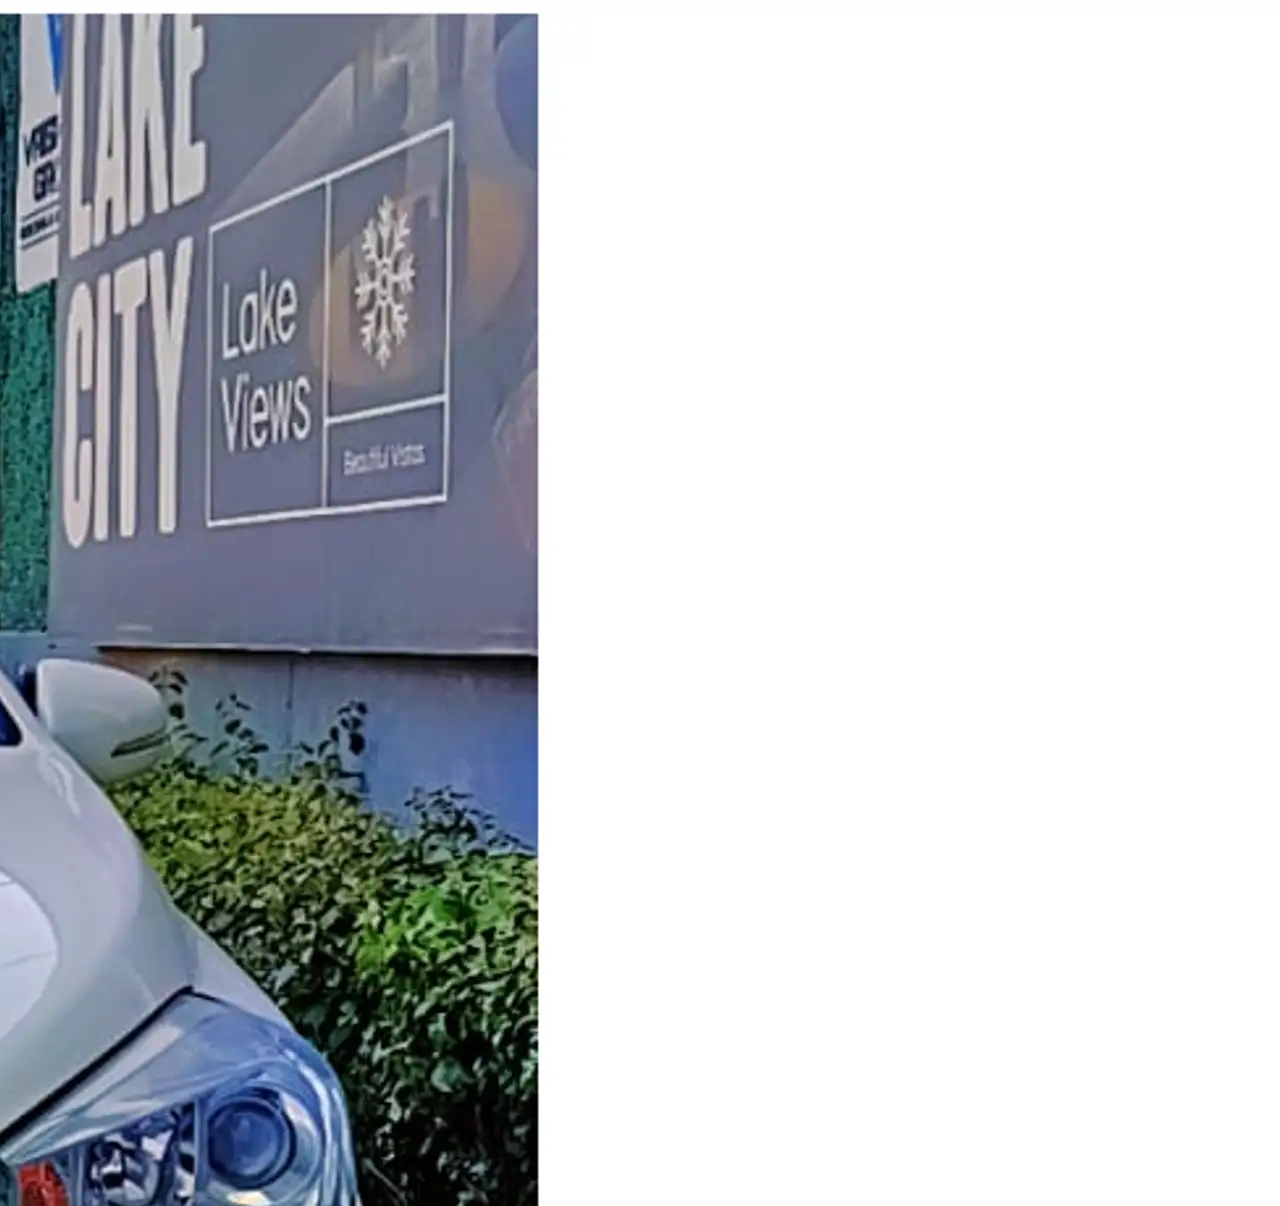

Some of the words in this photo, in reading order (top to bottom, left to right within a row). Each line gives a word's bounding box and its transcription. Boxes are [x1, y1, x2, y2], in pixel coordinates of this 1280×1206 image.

[70, 14, 207, 260] LAKE
[62, 236, 194, 548] CITY
[221, 268, 298, 361] Lake
[221, 373, 312, 453] Views
